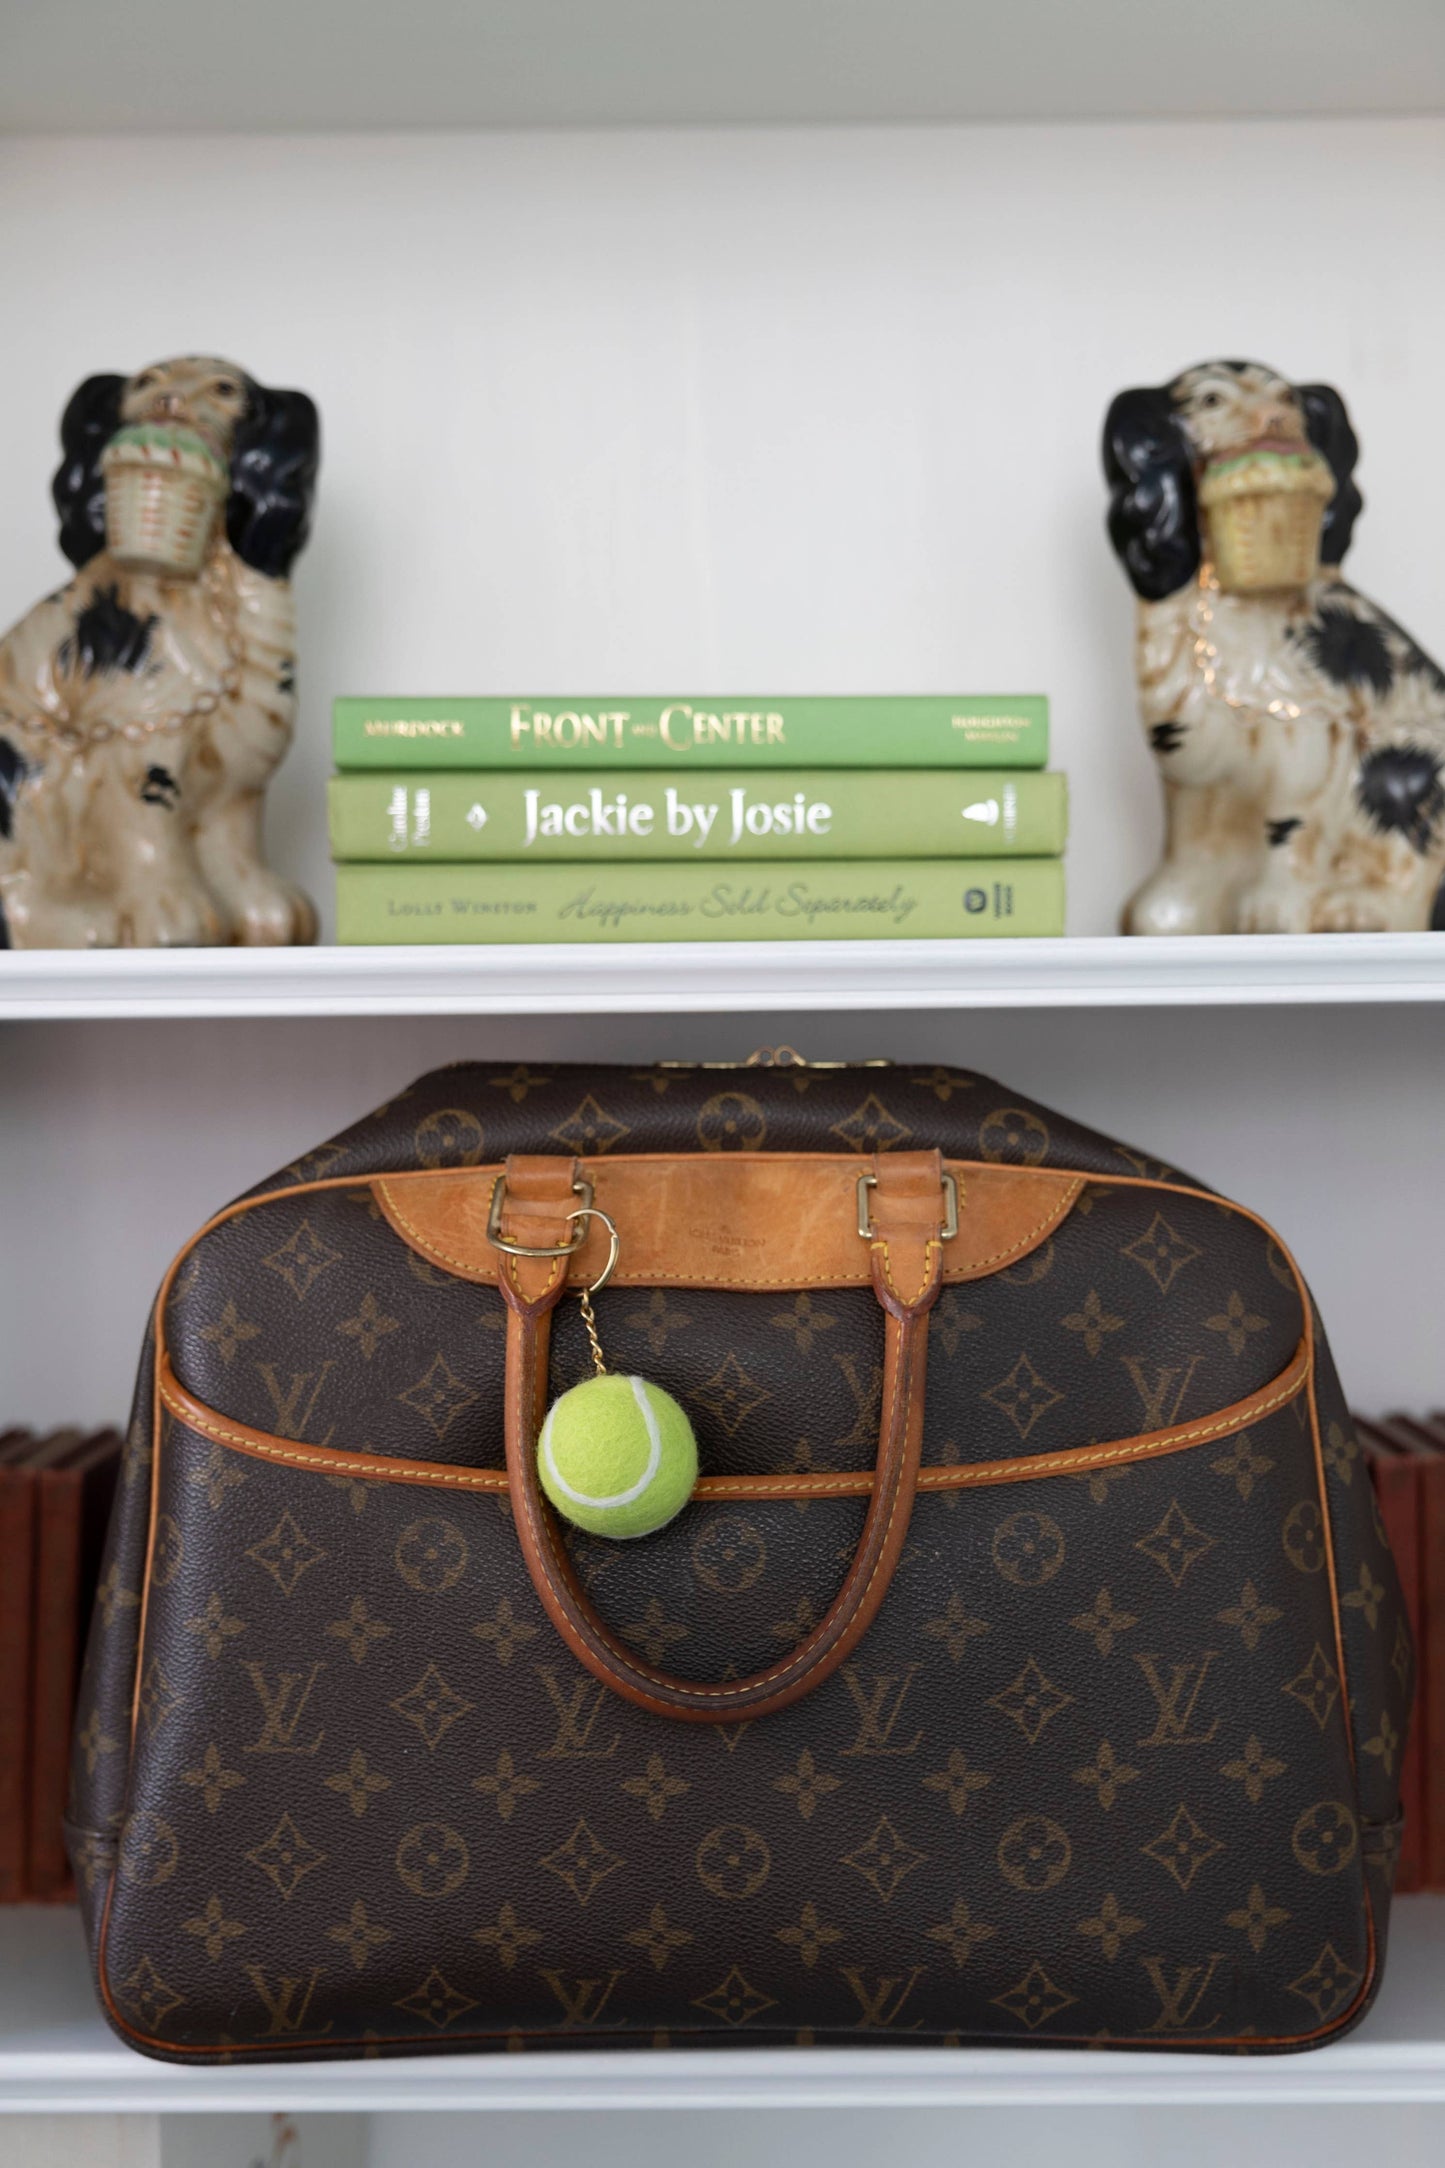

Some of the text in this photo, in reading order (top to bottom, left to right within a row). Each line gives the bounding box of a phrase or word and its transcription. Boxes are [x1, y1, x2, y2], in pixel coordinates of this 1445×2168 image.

[510, 702, 787, 751] FRONT CENTER
[522, 787, 833, 849] Jackie by Josie
[556, 881, 918, 929] Happiness Sold Separately
